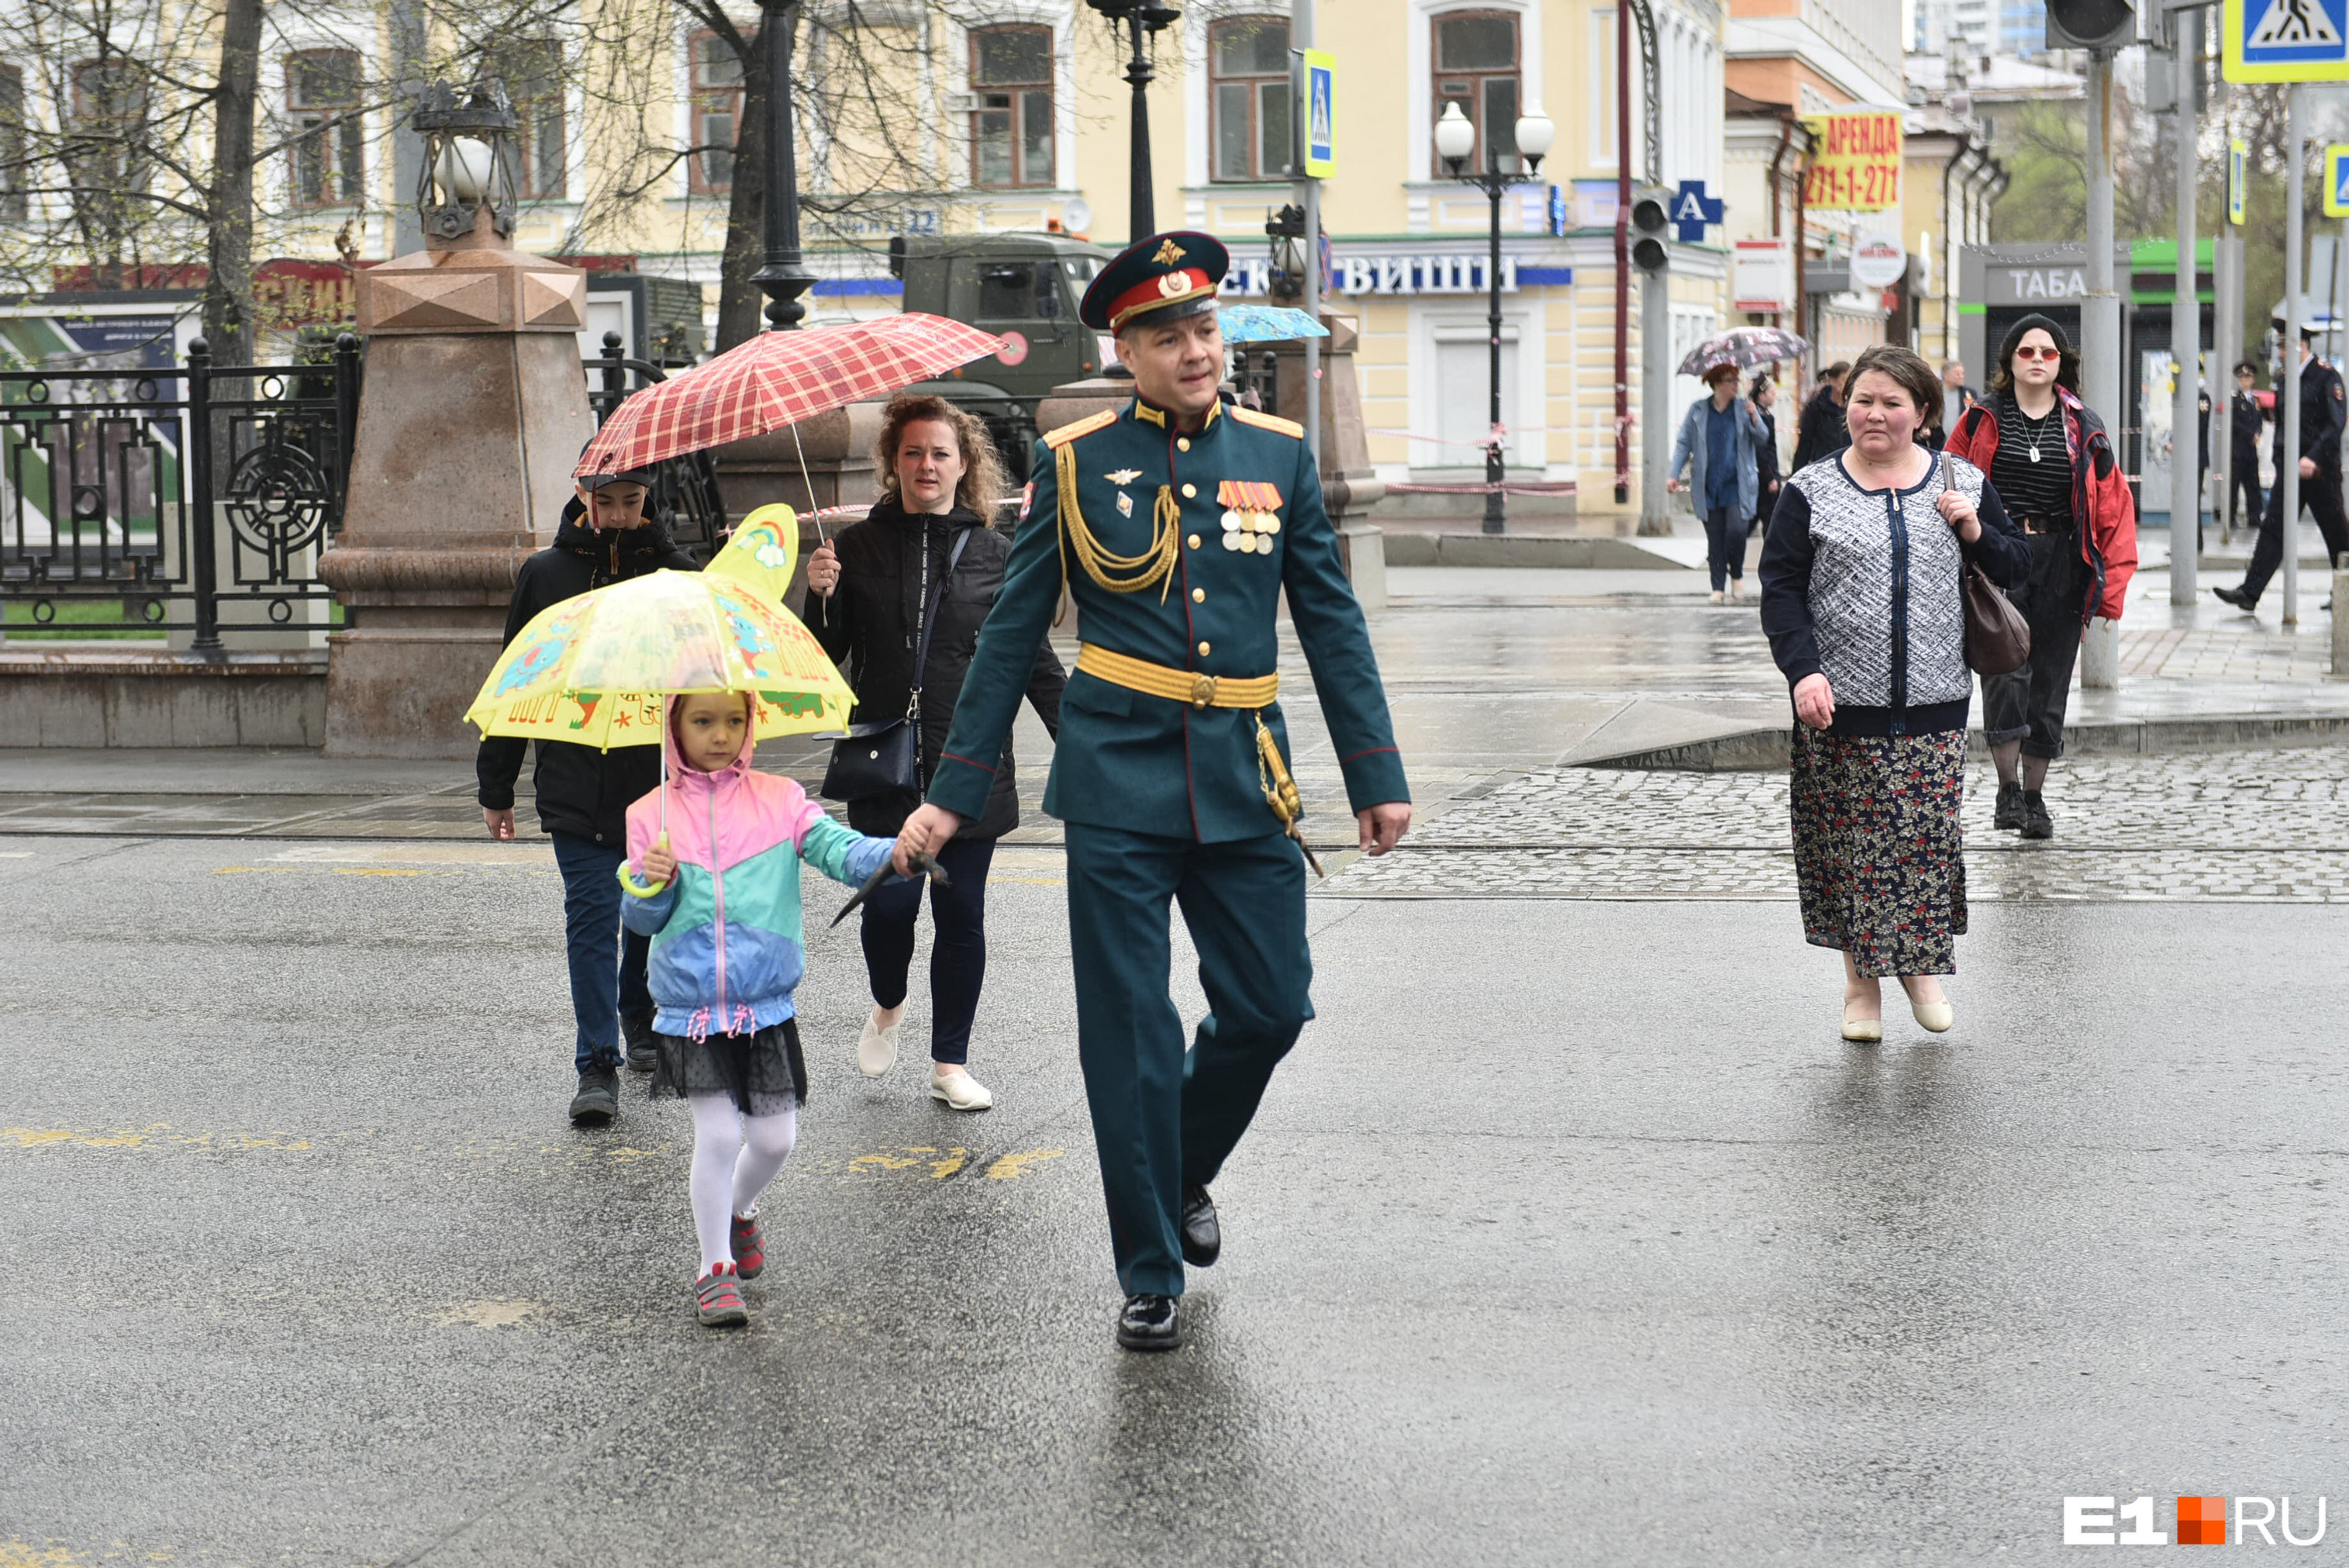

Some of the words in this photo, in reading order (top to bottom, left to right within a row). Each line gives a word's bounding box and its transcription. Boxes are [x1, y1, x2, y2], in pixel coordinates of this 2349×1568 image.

[1828, 117, 1897, 160] АРЕНДА
[1804, 165, 1898, 204] 271-1-271
[1676, 191, 1708, 221] А
